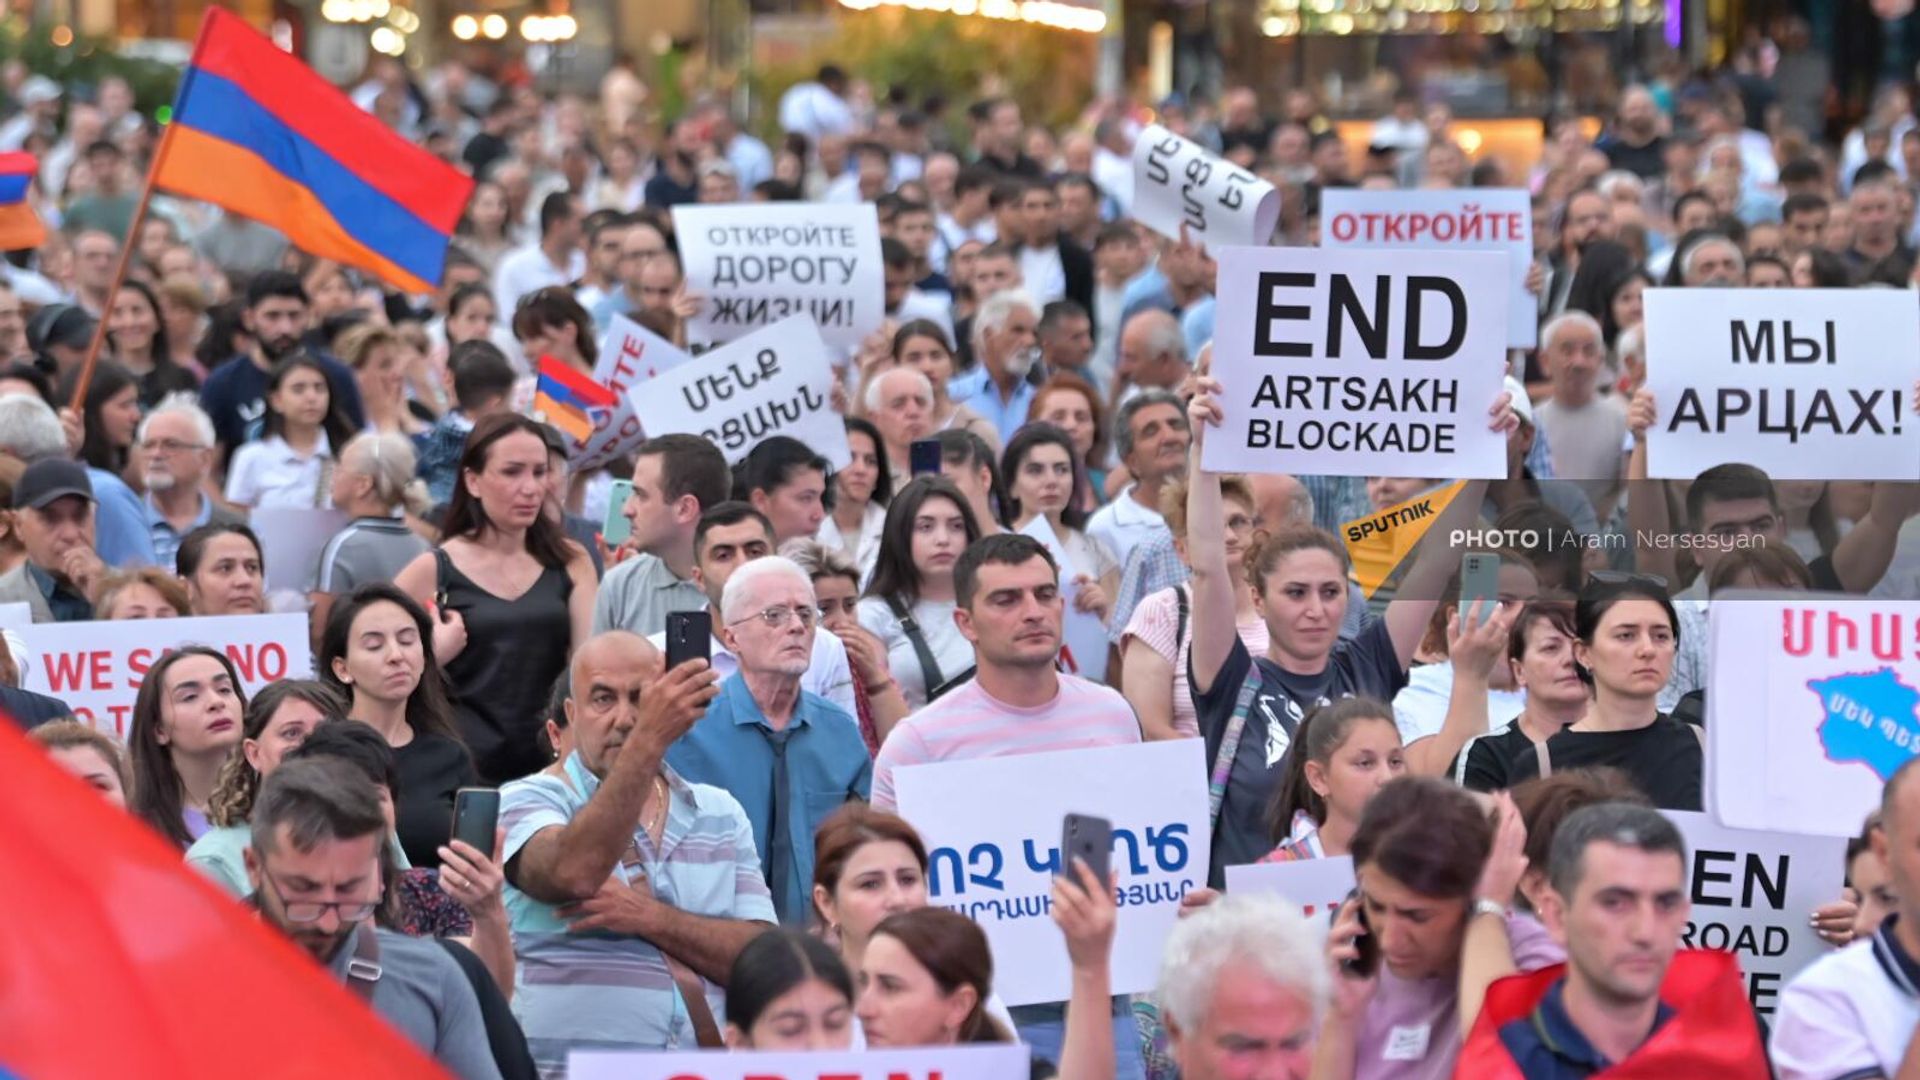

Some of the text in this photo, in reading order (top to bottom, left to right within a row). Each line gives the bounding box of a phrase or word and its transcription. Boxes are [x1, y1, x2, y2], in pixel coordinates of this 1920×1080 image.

[708, 221, 857, 248] ОТКРОЙТЕ
[1331, 204, 1524, 241] ОТКРОЙТЕ
[712, 256, 857, 287] ДОРОГУ
[1253, 271, 1468, 360] END
[1730, 319, 1837, 364] МЫ
[1251, 375, 1459, 413] ARTSAKH
[1667, 388, 1902, 443] АРЦАХ!
[1247, 419, 1456, 454] BLOCKADE
[43, 650, 112, 692] WE
[226, 642, 288, 683] NO
[1022, 822, 1189, 884] ԿՂԾ
[1691, 850, 1790, 910] EN
